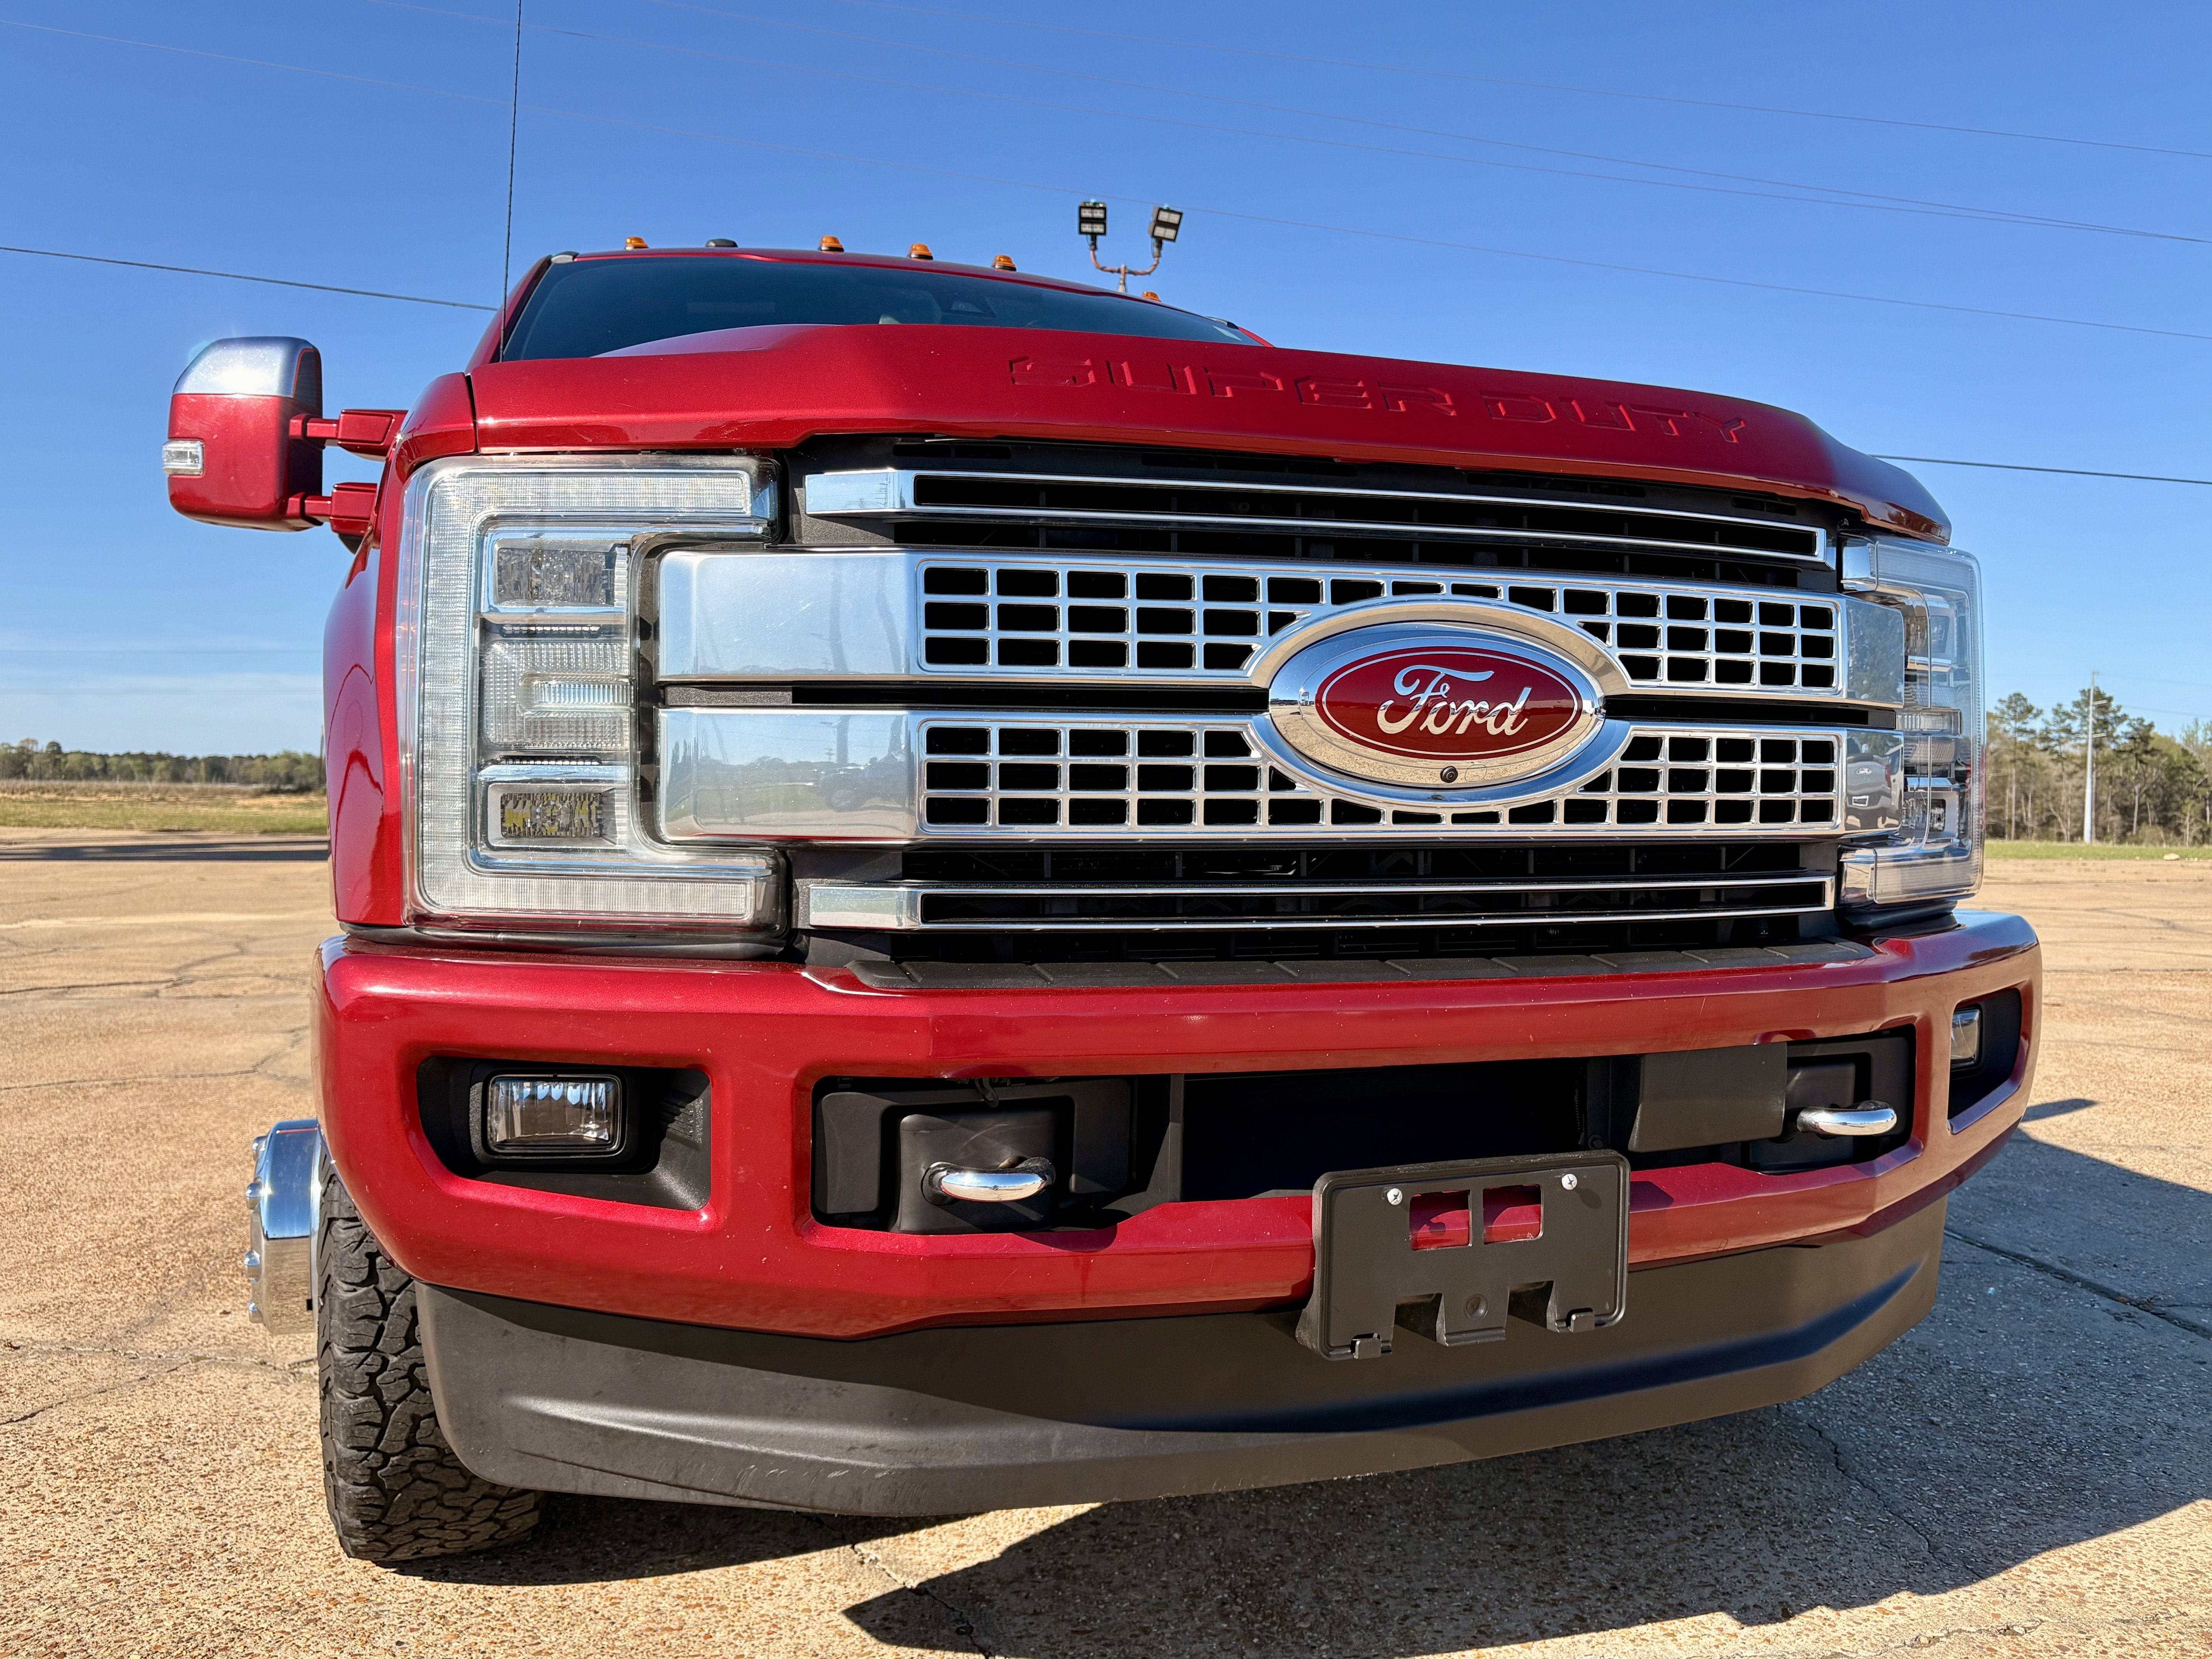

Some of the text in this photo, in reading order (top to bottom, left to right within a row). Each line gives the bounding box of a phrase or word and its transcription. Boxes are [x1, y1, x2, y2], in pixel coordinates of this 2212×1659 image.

[1008, 356, 1746, 443] SUPER DUTY
[1377, 664, 1532, 736] Ford
